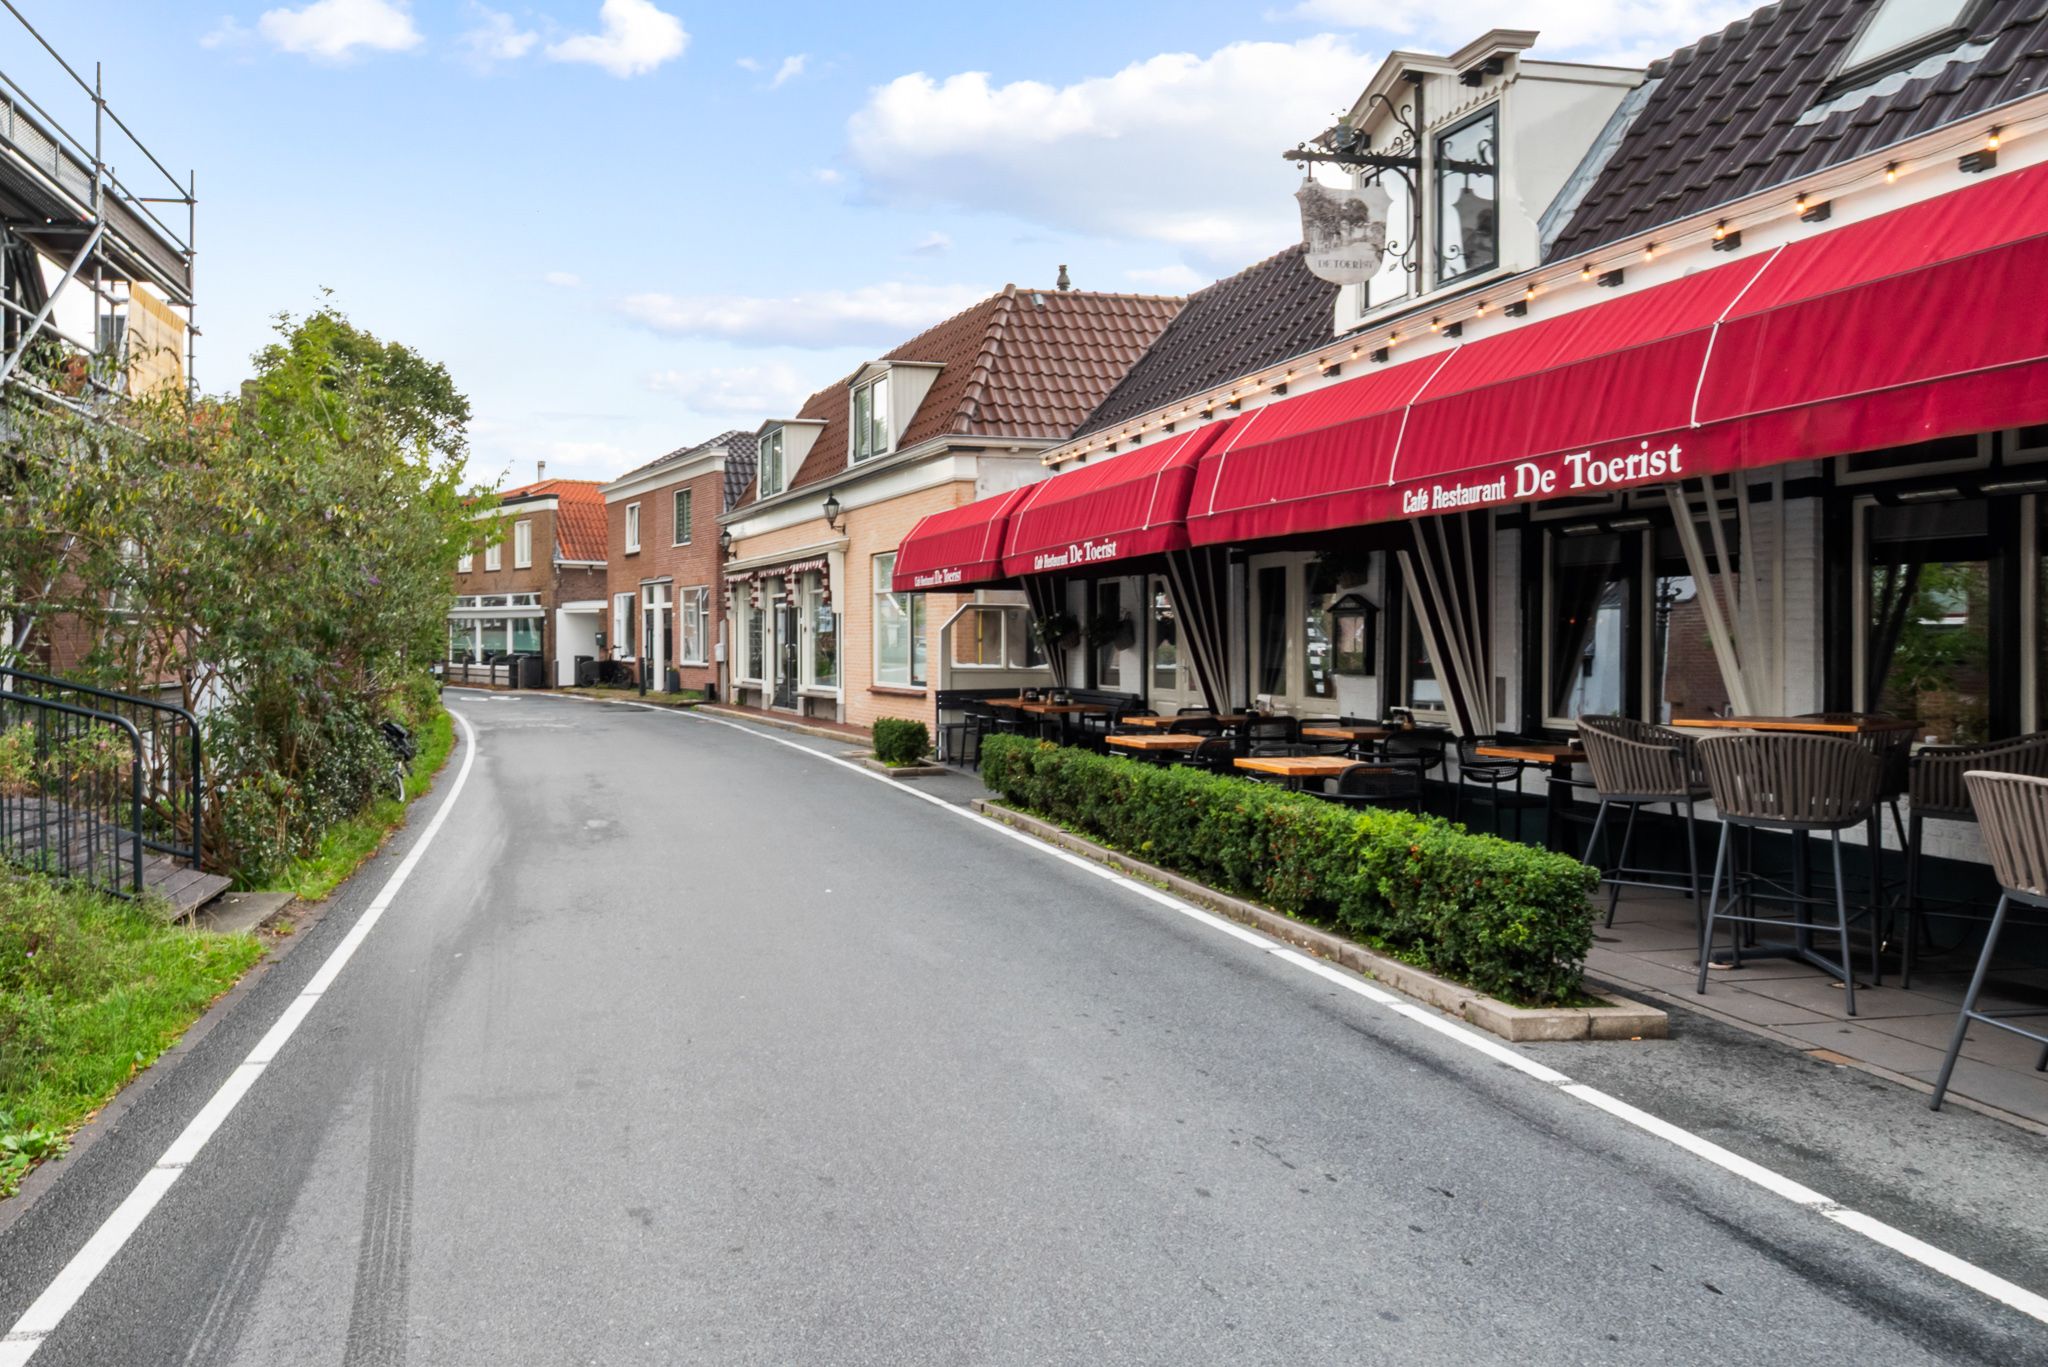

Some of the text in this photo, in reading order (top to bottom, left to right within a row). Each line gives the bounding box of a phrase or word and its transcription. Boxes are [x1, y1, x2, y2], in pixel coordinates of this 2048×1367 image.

[1403, 440, 1683, 514] Café Restaurant De Toerist
[1069, 544, 1082, 564] De
[1084, 538, 1117, 561] Toerist
